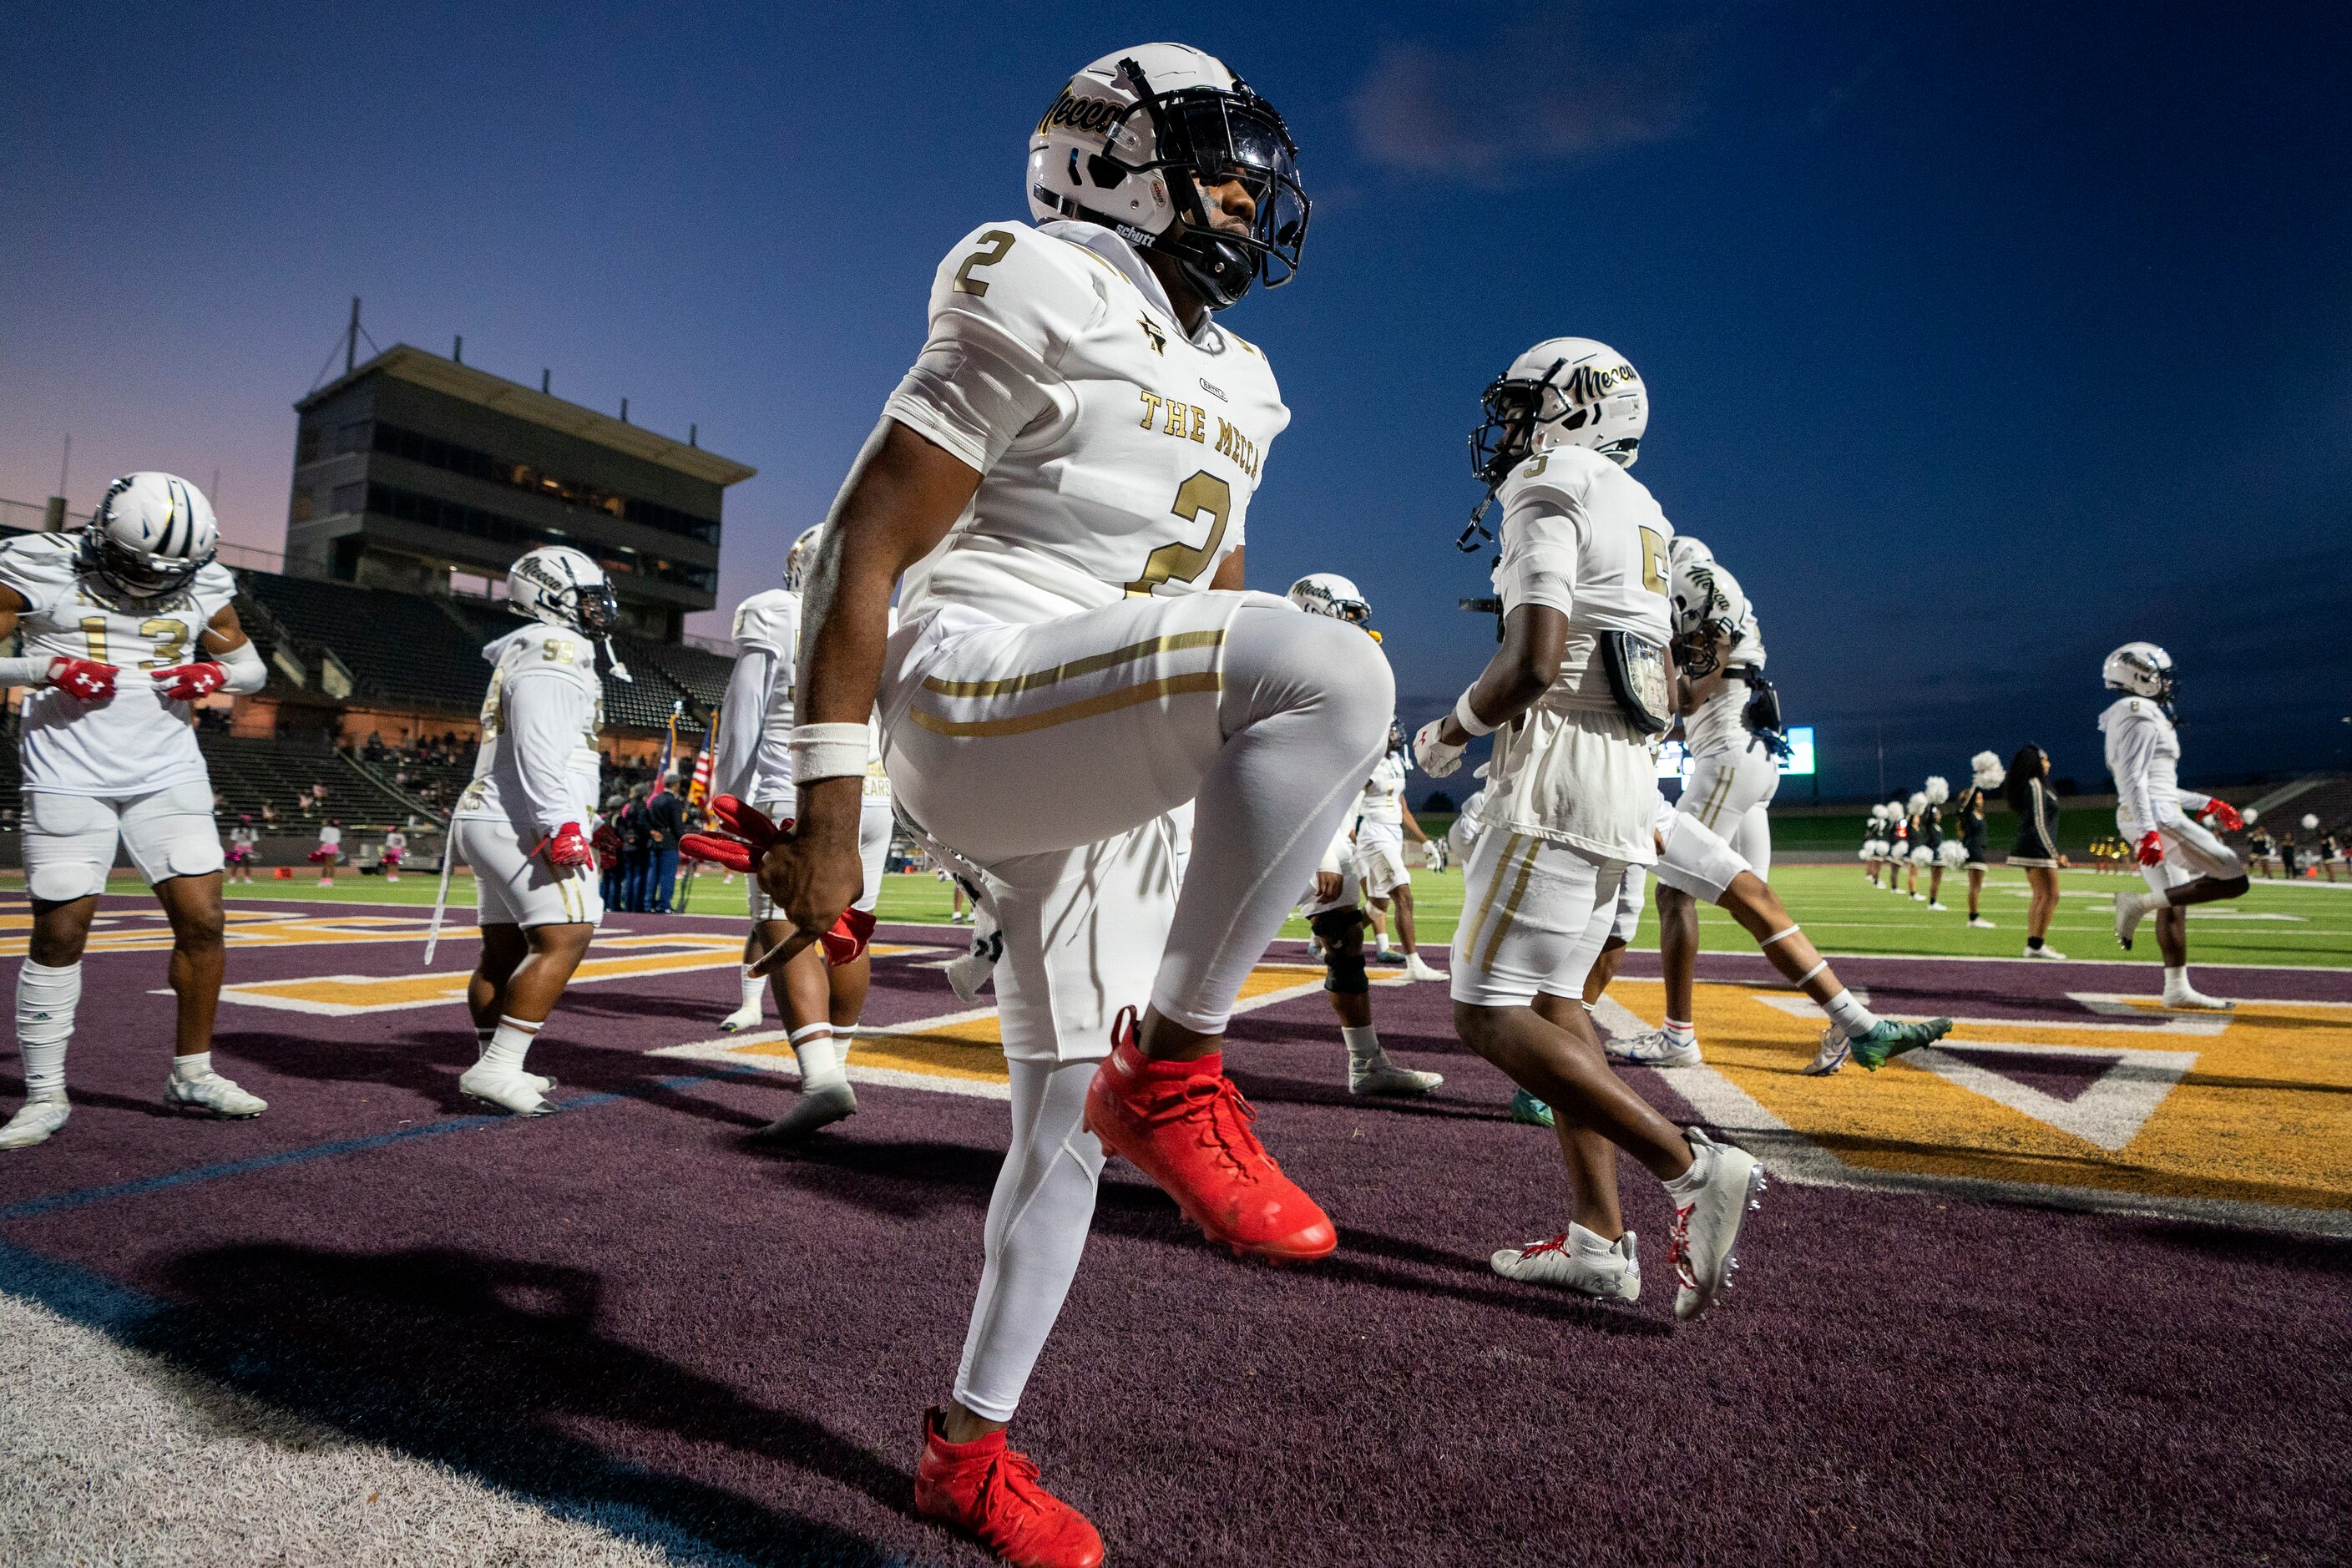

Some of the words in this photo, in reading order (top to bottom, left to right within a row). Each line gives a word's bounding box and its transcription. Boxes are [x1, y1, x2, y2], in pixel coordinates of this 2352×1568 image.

[953, 230, 1016, 297] 2
[1115, 224, 1156, 248] schutt
[1140, 390, 1206, 444] THE
[1214, 416, 1259, 482] MECCA
[1123, 468, 1232, 600] 2
[78, 615, 189, 670] 13
[543, 638, 575, 665] 99
